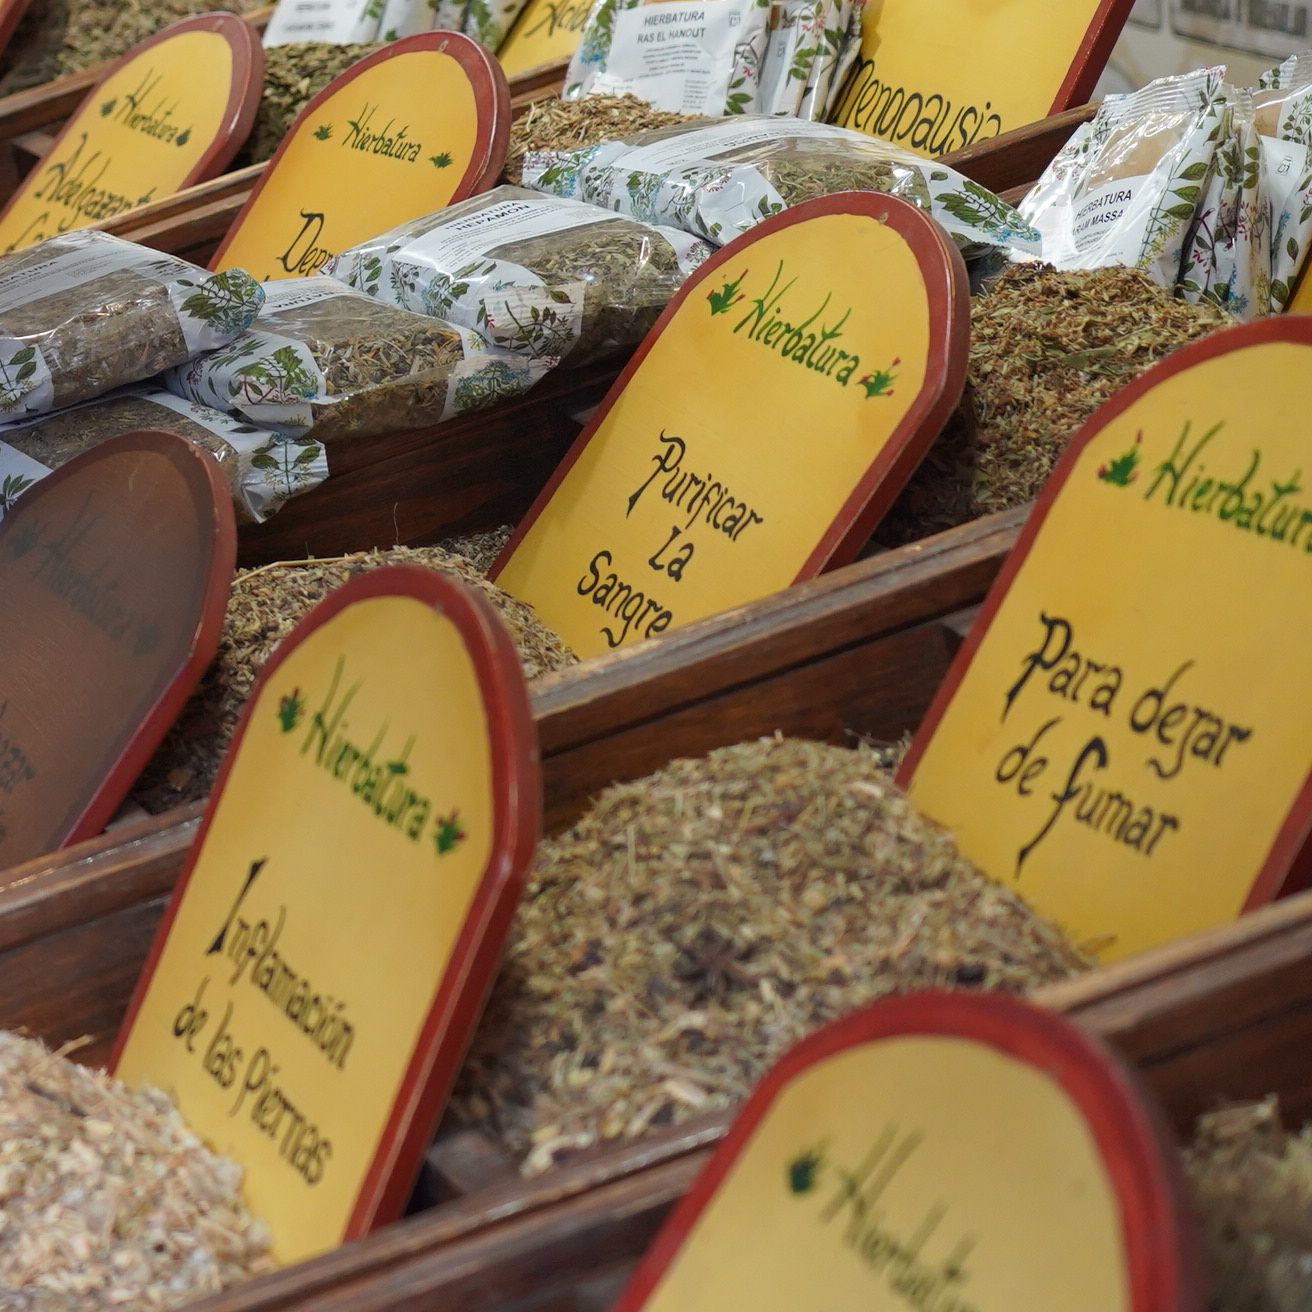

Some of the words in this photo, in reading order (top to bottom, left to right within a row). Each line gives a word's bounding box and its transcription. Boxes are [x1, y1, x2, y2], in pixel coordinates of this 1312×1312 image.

[636, 32, 655, 45] RAS
[656, 31, 667, 43] EL
[668, 27, 706, 41] HANOUT
[643, 10, 706, 27] HIERBATURA
[114, 66, 180, 144] Hierbatura
[341, 100, 424, 165] Hierbatura
[455, 205, 531, 232] HEPAMON
[732, 258, 864, 389] Hierbatura
[625, 428, 764, 543] Purificar
[576, 549, 674, 649] Sangre
[648, 526, 697, 584] La
[1000, 610, 1124, 725] Para
[1128, 660, 1254, 782] dejar
[298, 653, 432, 846] Hierbatura
[995, 716, 1065, 797] de
[1013, 735, 1182, 881] fumar
[204, 856, 356, 1072] Inflamación
[172, 974, 210, 1056] de
[201, 1000, 245, 1100] las
[228, 1046, 334, 1188] Piernas
